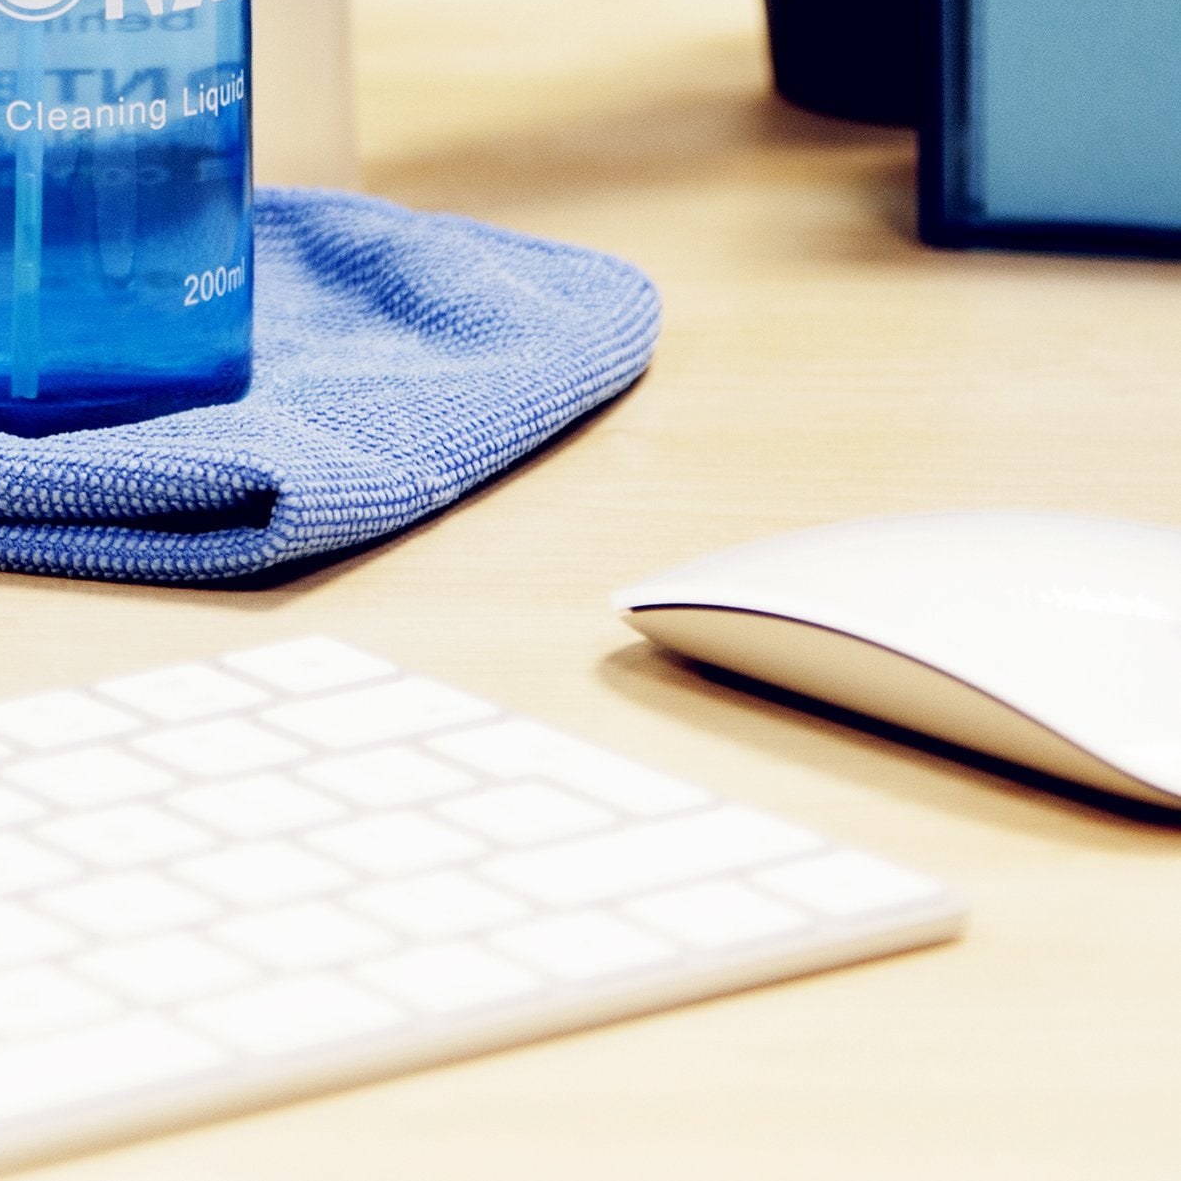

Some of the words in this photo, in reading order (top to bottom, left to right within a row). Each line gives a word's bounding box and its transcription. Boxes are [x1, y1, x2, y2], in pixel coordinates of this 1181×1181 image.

[5, 96, 168, 131] Cleaning
[183, 69, 244, 117] Liquid
[184, 256, 245, 307] 200ml
